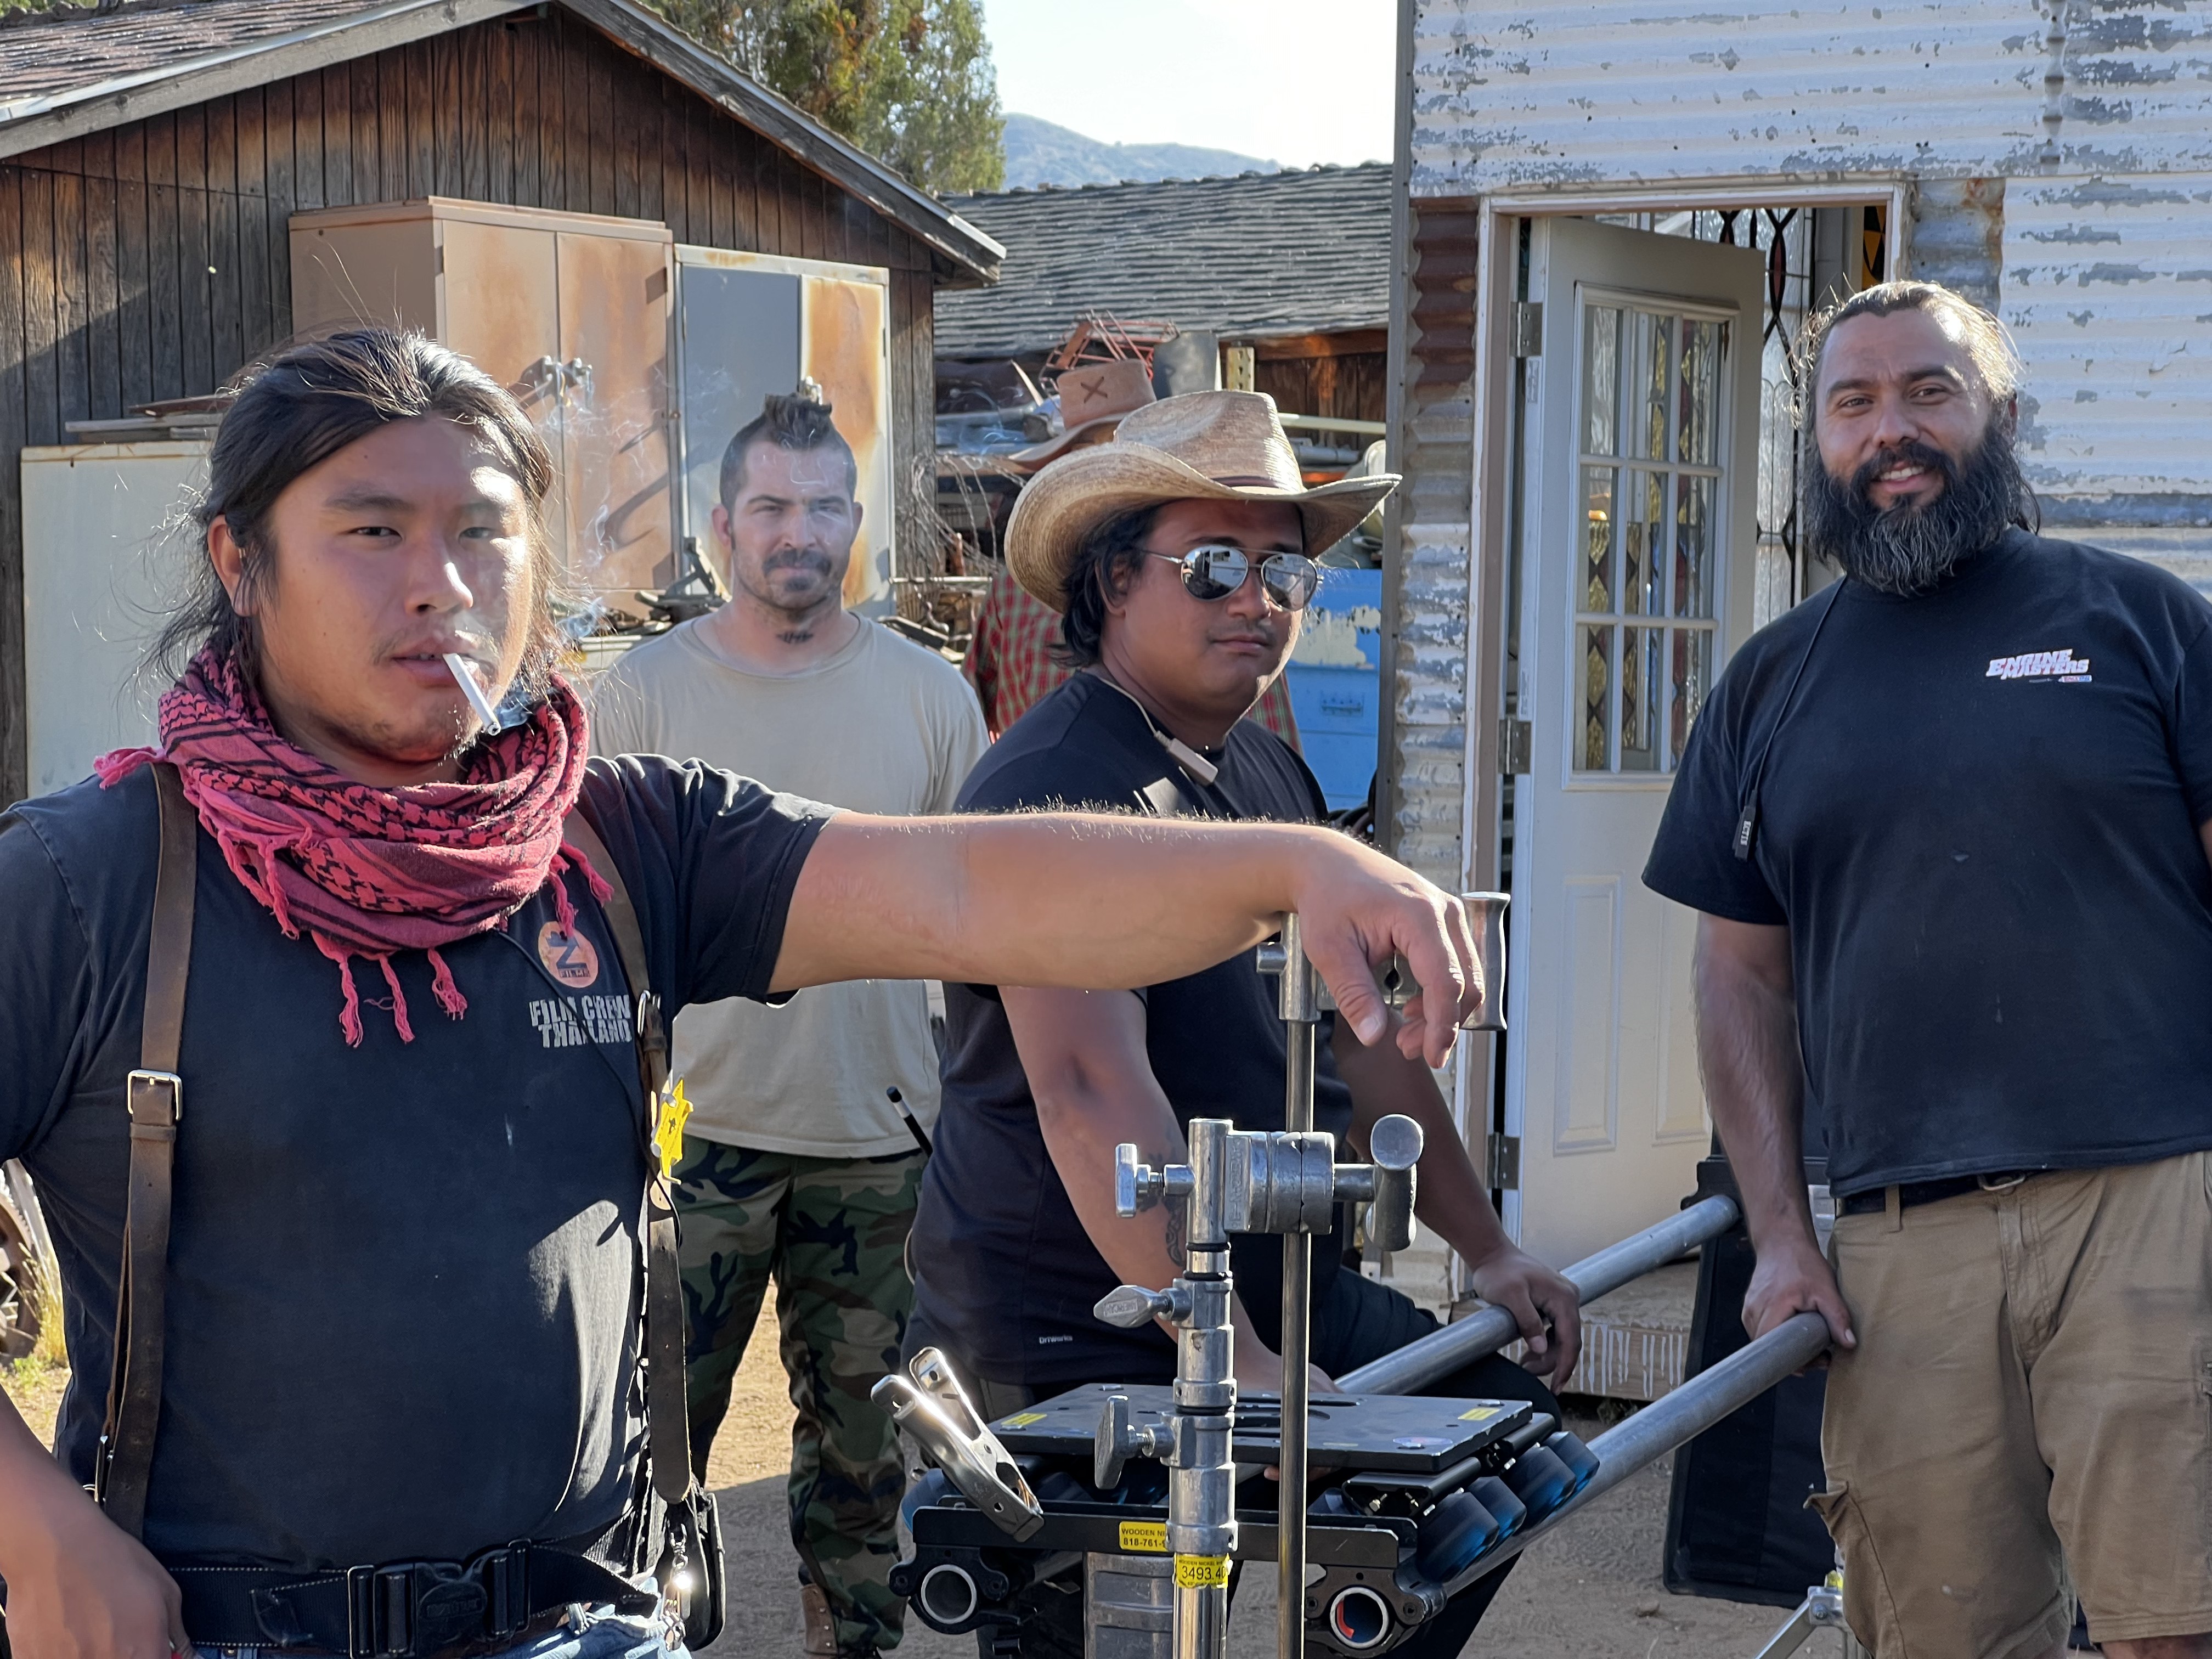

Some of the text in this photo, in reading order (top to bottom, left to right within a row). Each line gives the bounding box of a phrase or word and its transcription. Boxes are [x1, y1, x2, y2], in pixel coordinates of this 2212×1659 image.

[1986, 649, 2073, 676] ENGINE
[2000, 659, 2090, 680] MASTERS
[529, 994, 631, 1026] FILM CREW
[538, 1019, 632, 1048] THAILAND
[1121, 1528, 1155, 1536] WOODEN
